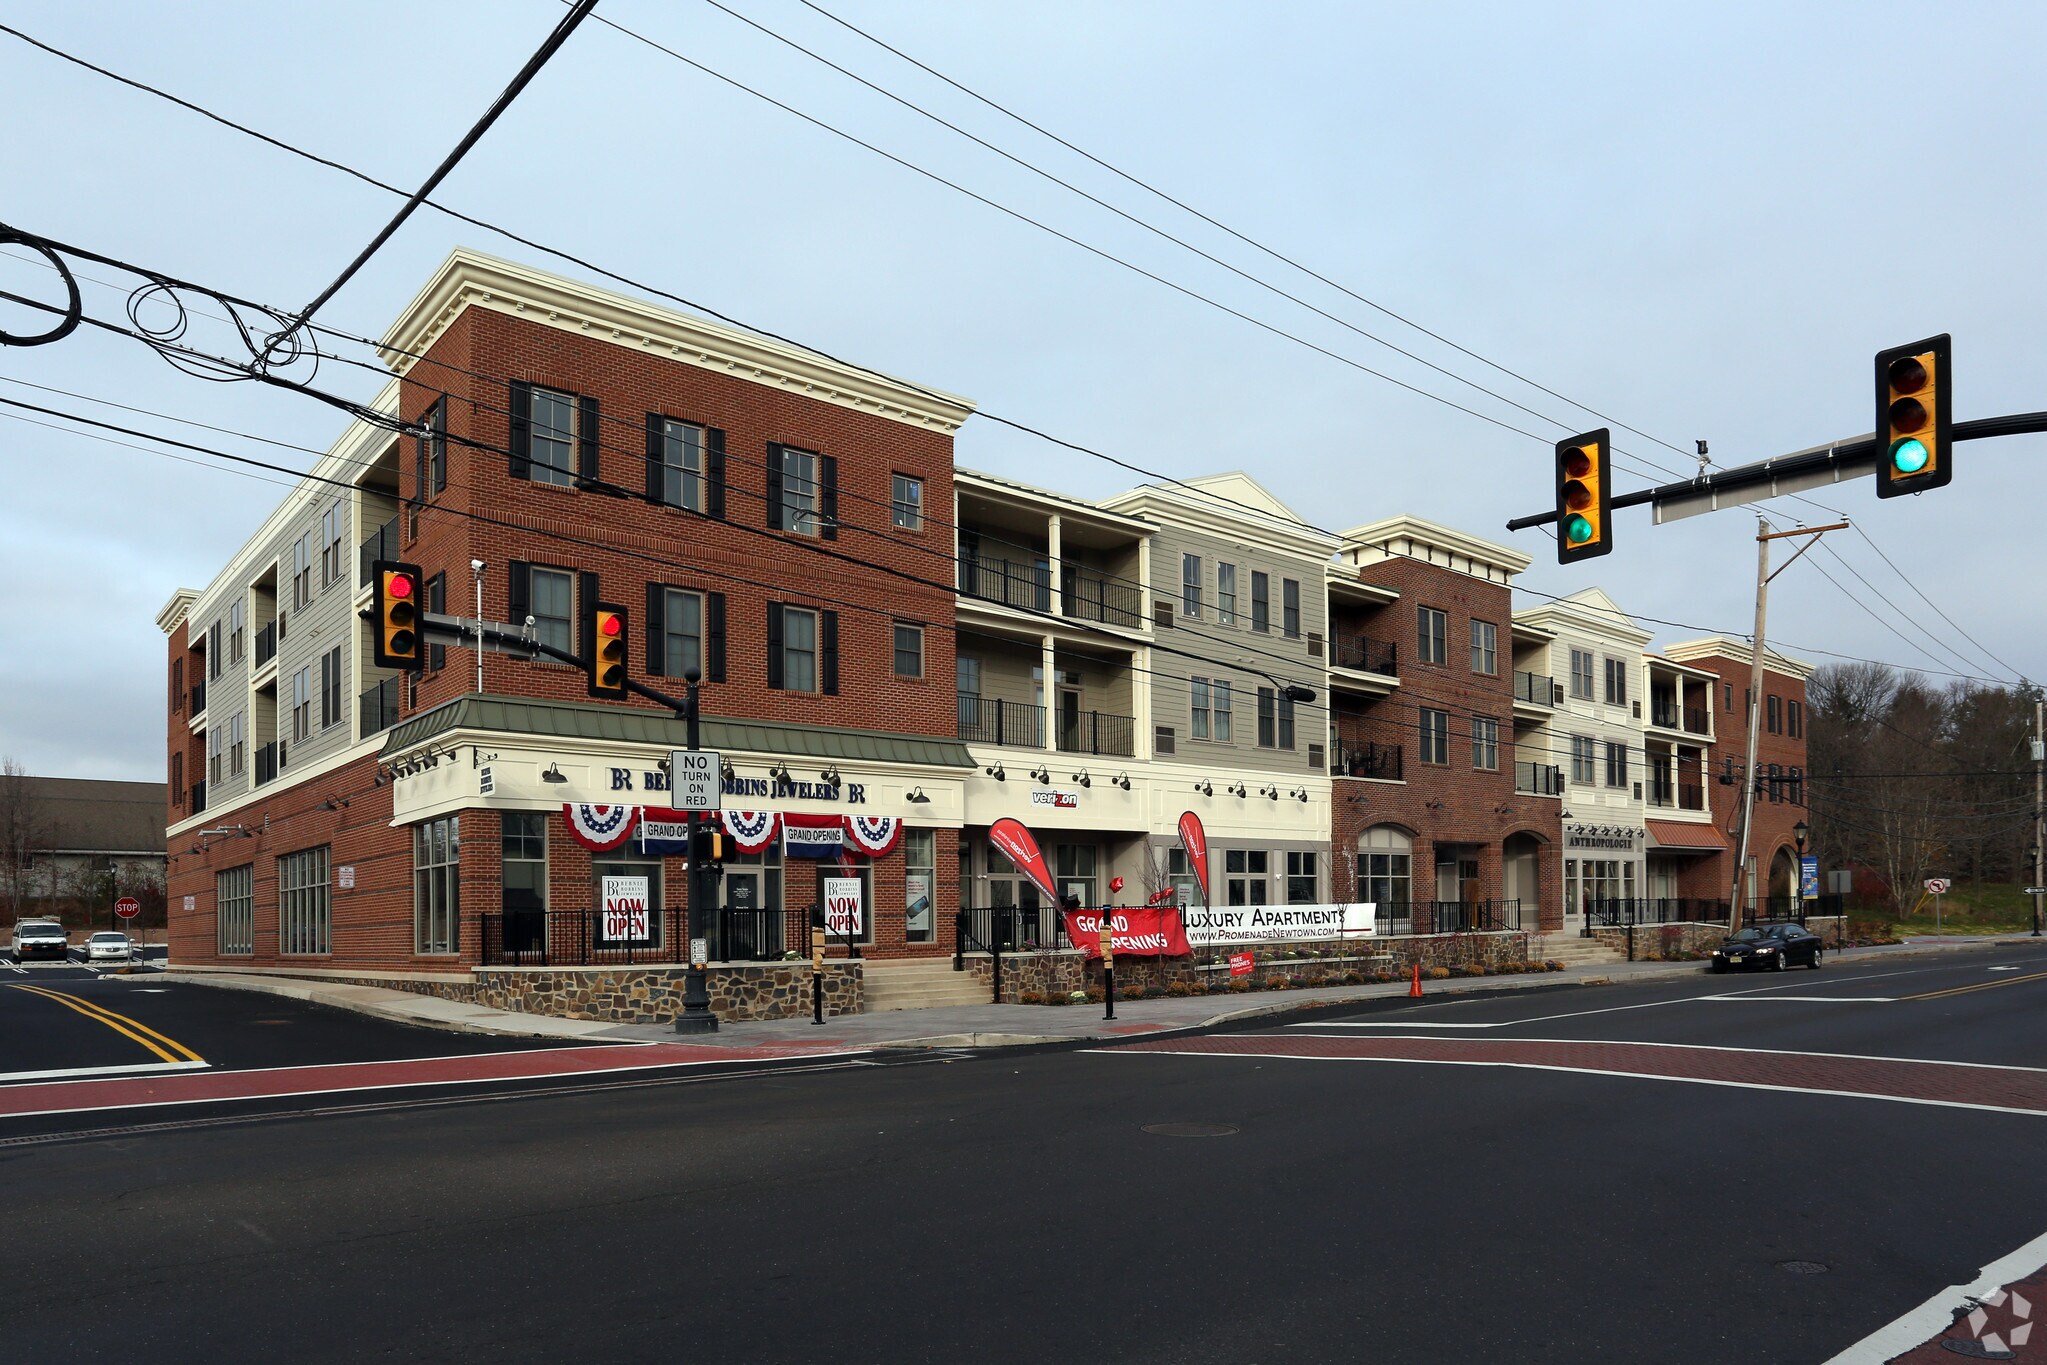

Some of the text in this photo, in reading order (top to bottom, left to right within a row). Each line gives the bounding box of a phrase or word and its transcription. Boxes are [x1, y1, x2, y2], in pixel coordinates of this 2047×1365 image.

[684, 755, 708, 769] NO
[610, 767, 632, 790] BR
[682, 771, 711, 781] TURN
[689, 783, 704, 793] ON
[770, 780, 840, 801] JEWELERS
[848, 783, 866, 804] BR
[686, 795, 707, 806] RED
[1032, 790, 1078, 808] verizon
[647, 824, 675, 837] GRAND
[788, 828, 812, 841] GRAND
[812, 830, 841, 841] OPENING
[1569, 837, 1633, 849] ANTHROPOLOGIE
[607, 880, 620, 896] BR
[828, 881, 839, 896] BR
[116, 903, 138, 912] STOP
[607, 898, 645, 916] NOW
[828, 897, 859, 914] NOW
[828, 914, 859, 931] OPEN
[1251, 908, 1345, 926] APARTMENTS
[607, 918, 645, 936] OPEN
[1110, 933, 1168, 950] PENING
[1230, 956, 1243, 964] FREE
[1231, 959, 1251, 969] PHONES
